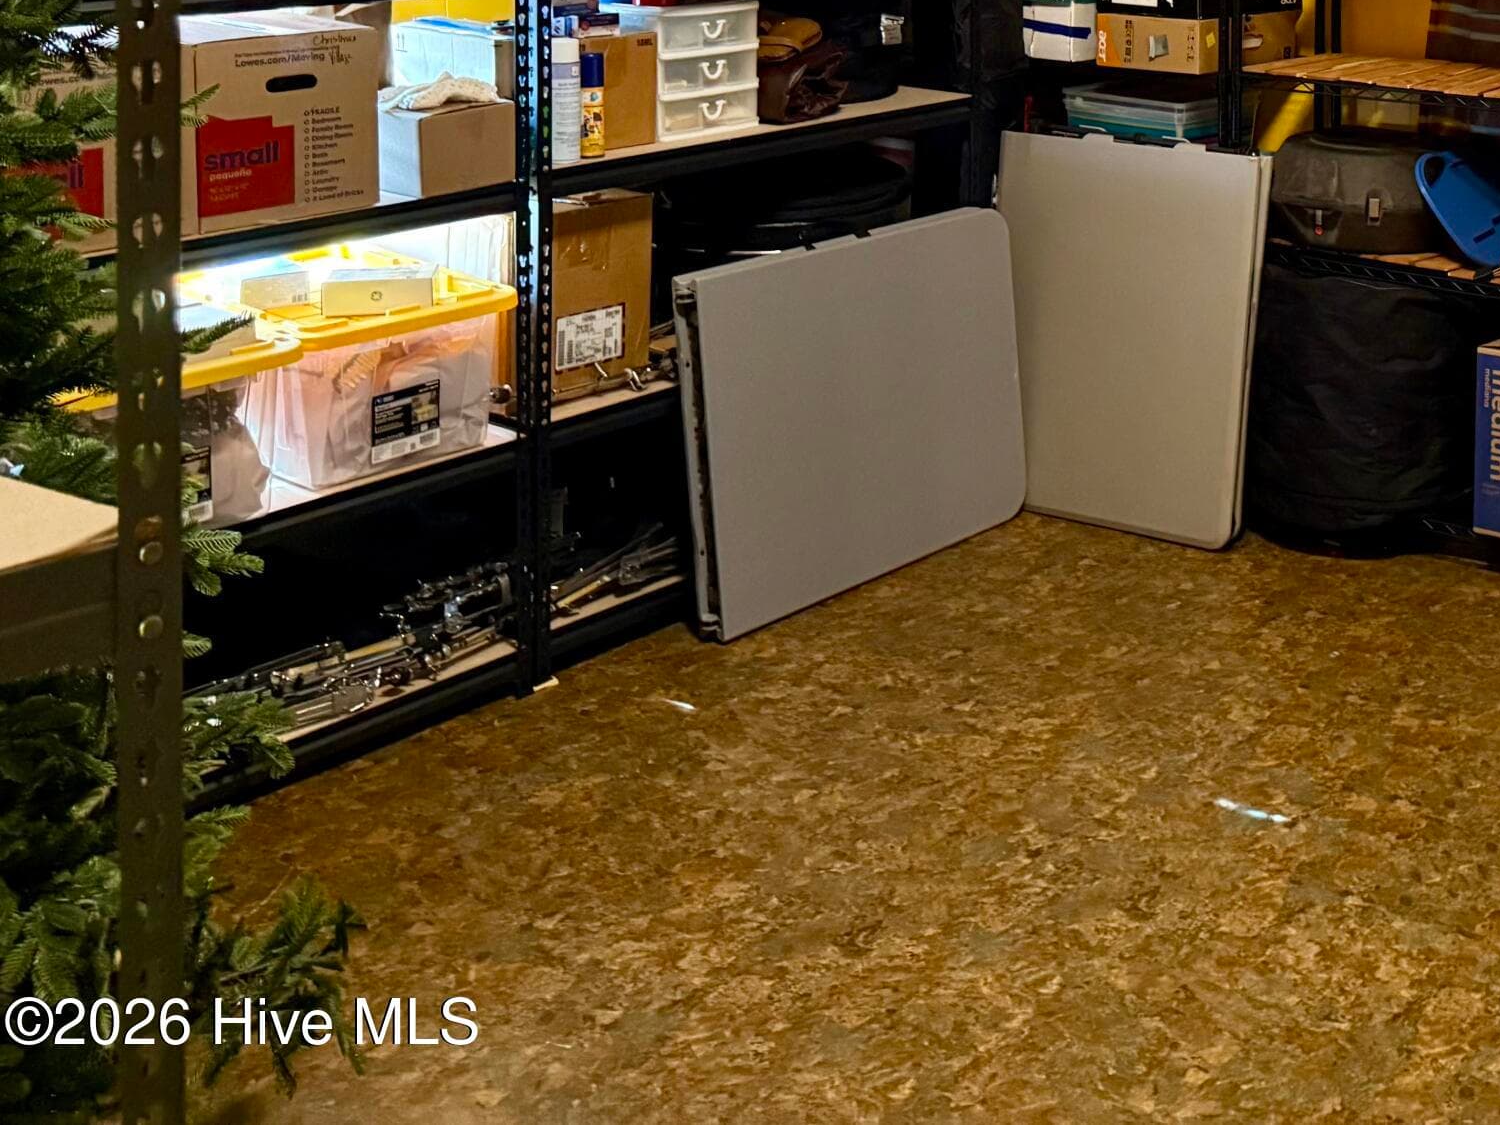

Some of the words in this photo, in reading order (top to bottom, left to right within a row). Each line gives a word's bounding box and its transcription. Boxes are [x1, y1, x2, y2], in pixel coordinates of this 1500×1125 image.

[235, 51, 325, 67] Lowes.com/Moving
[1098, 30, 1106, 63] acer
[204, 139, 280, 171] small
